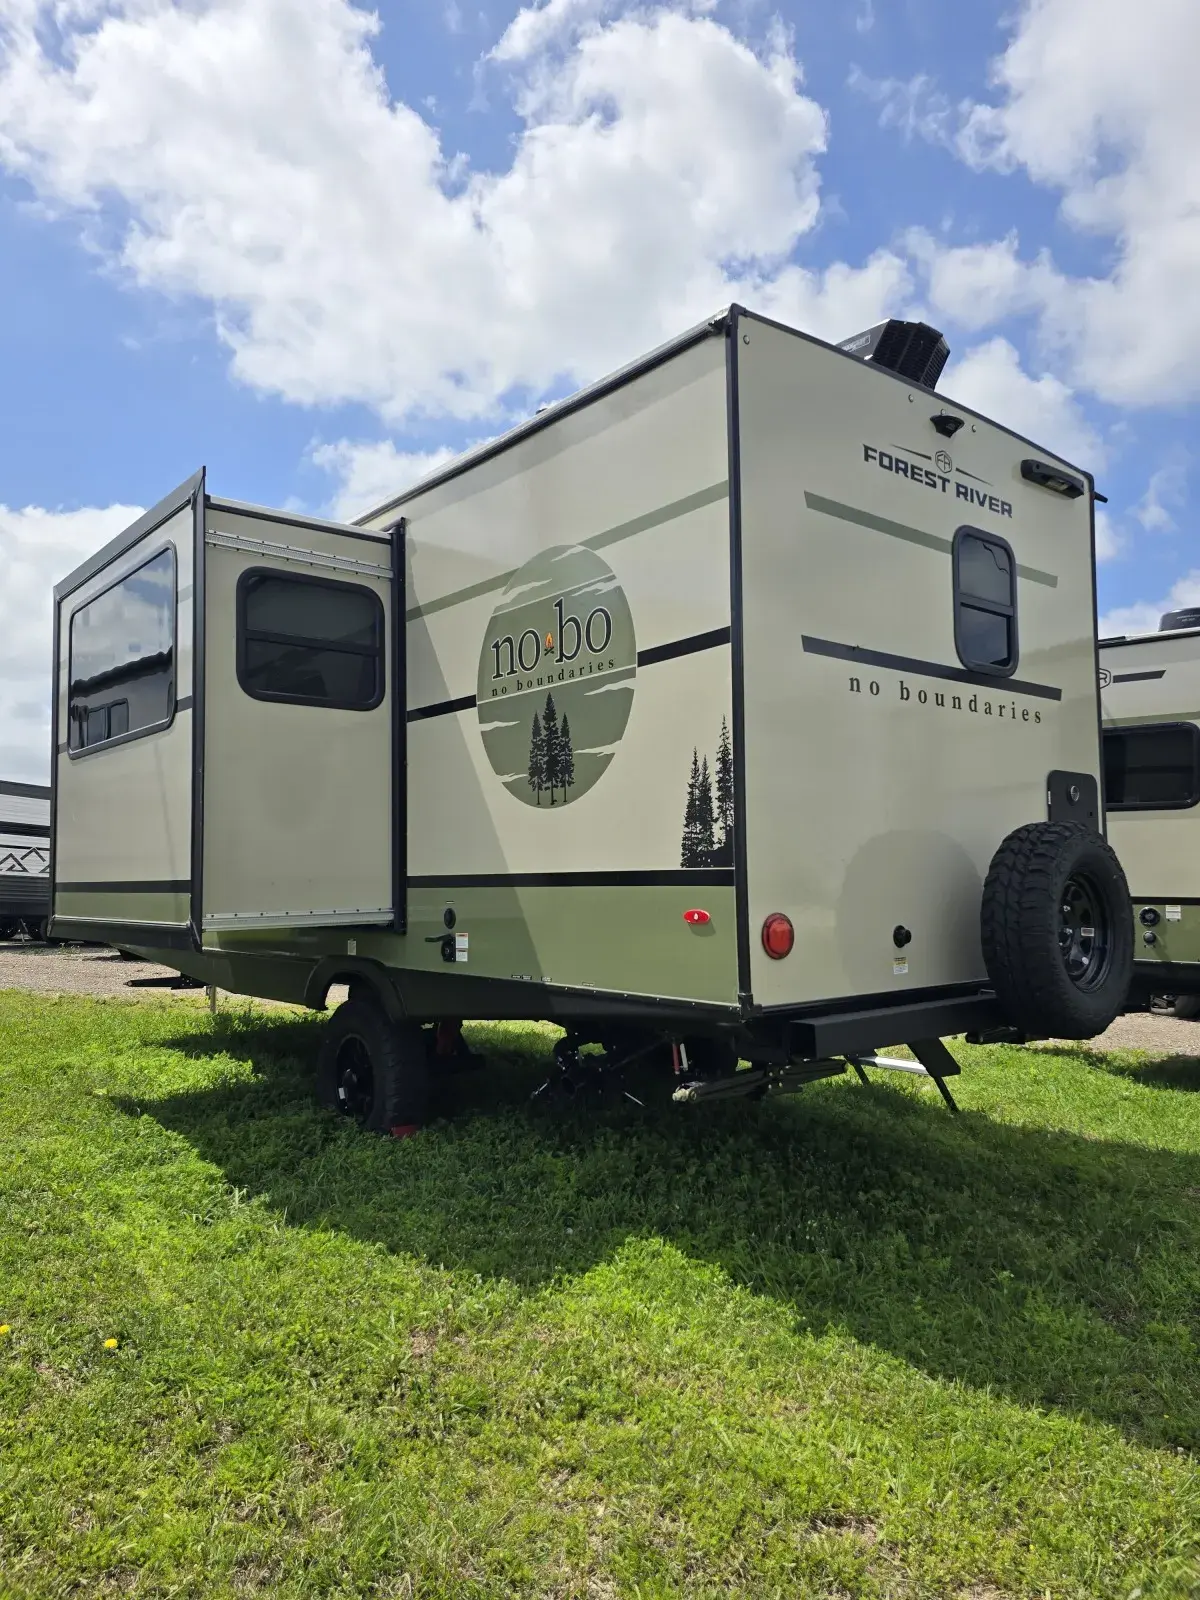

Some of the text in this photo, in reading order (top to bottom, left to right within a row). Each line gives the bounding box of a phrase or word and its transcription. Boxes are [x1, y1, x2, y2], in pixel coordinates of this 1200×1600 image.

[863, 444, 1013, 518] FOREST RIVER
[492, 659, 615, 697] no boundaries
[849, 677, 1042, 724] no boundaries
